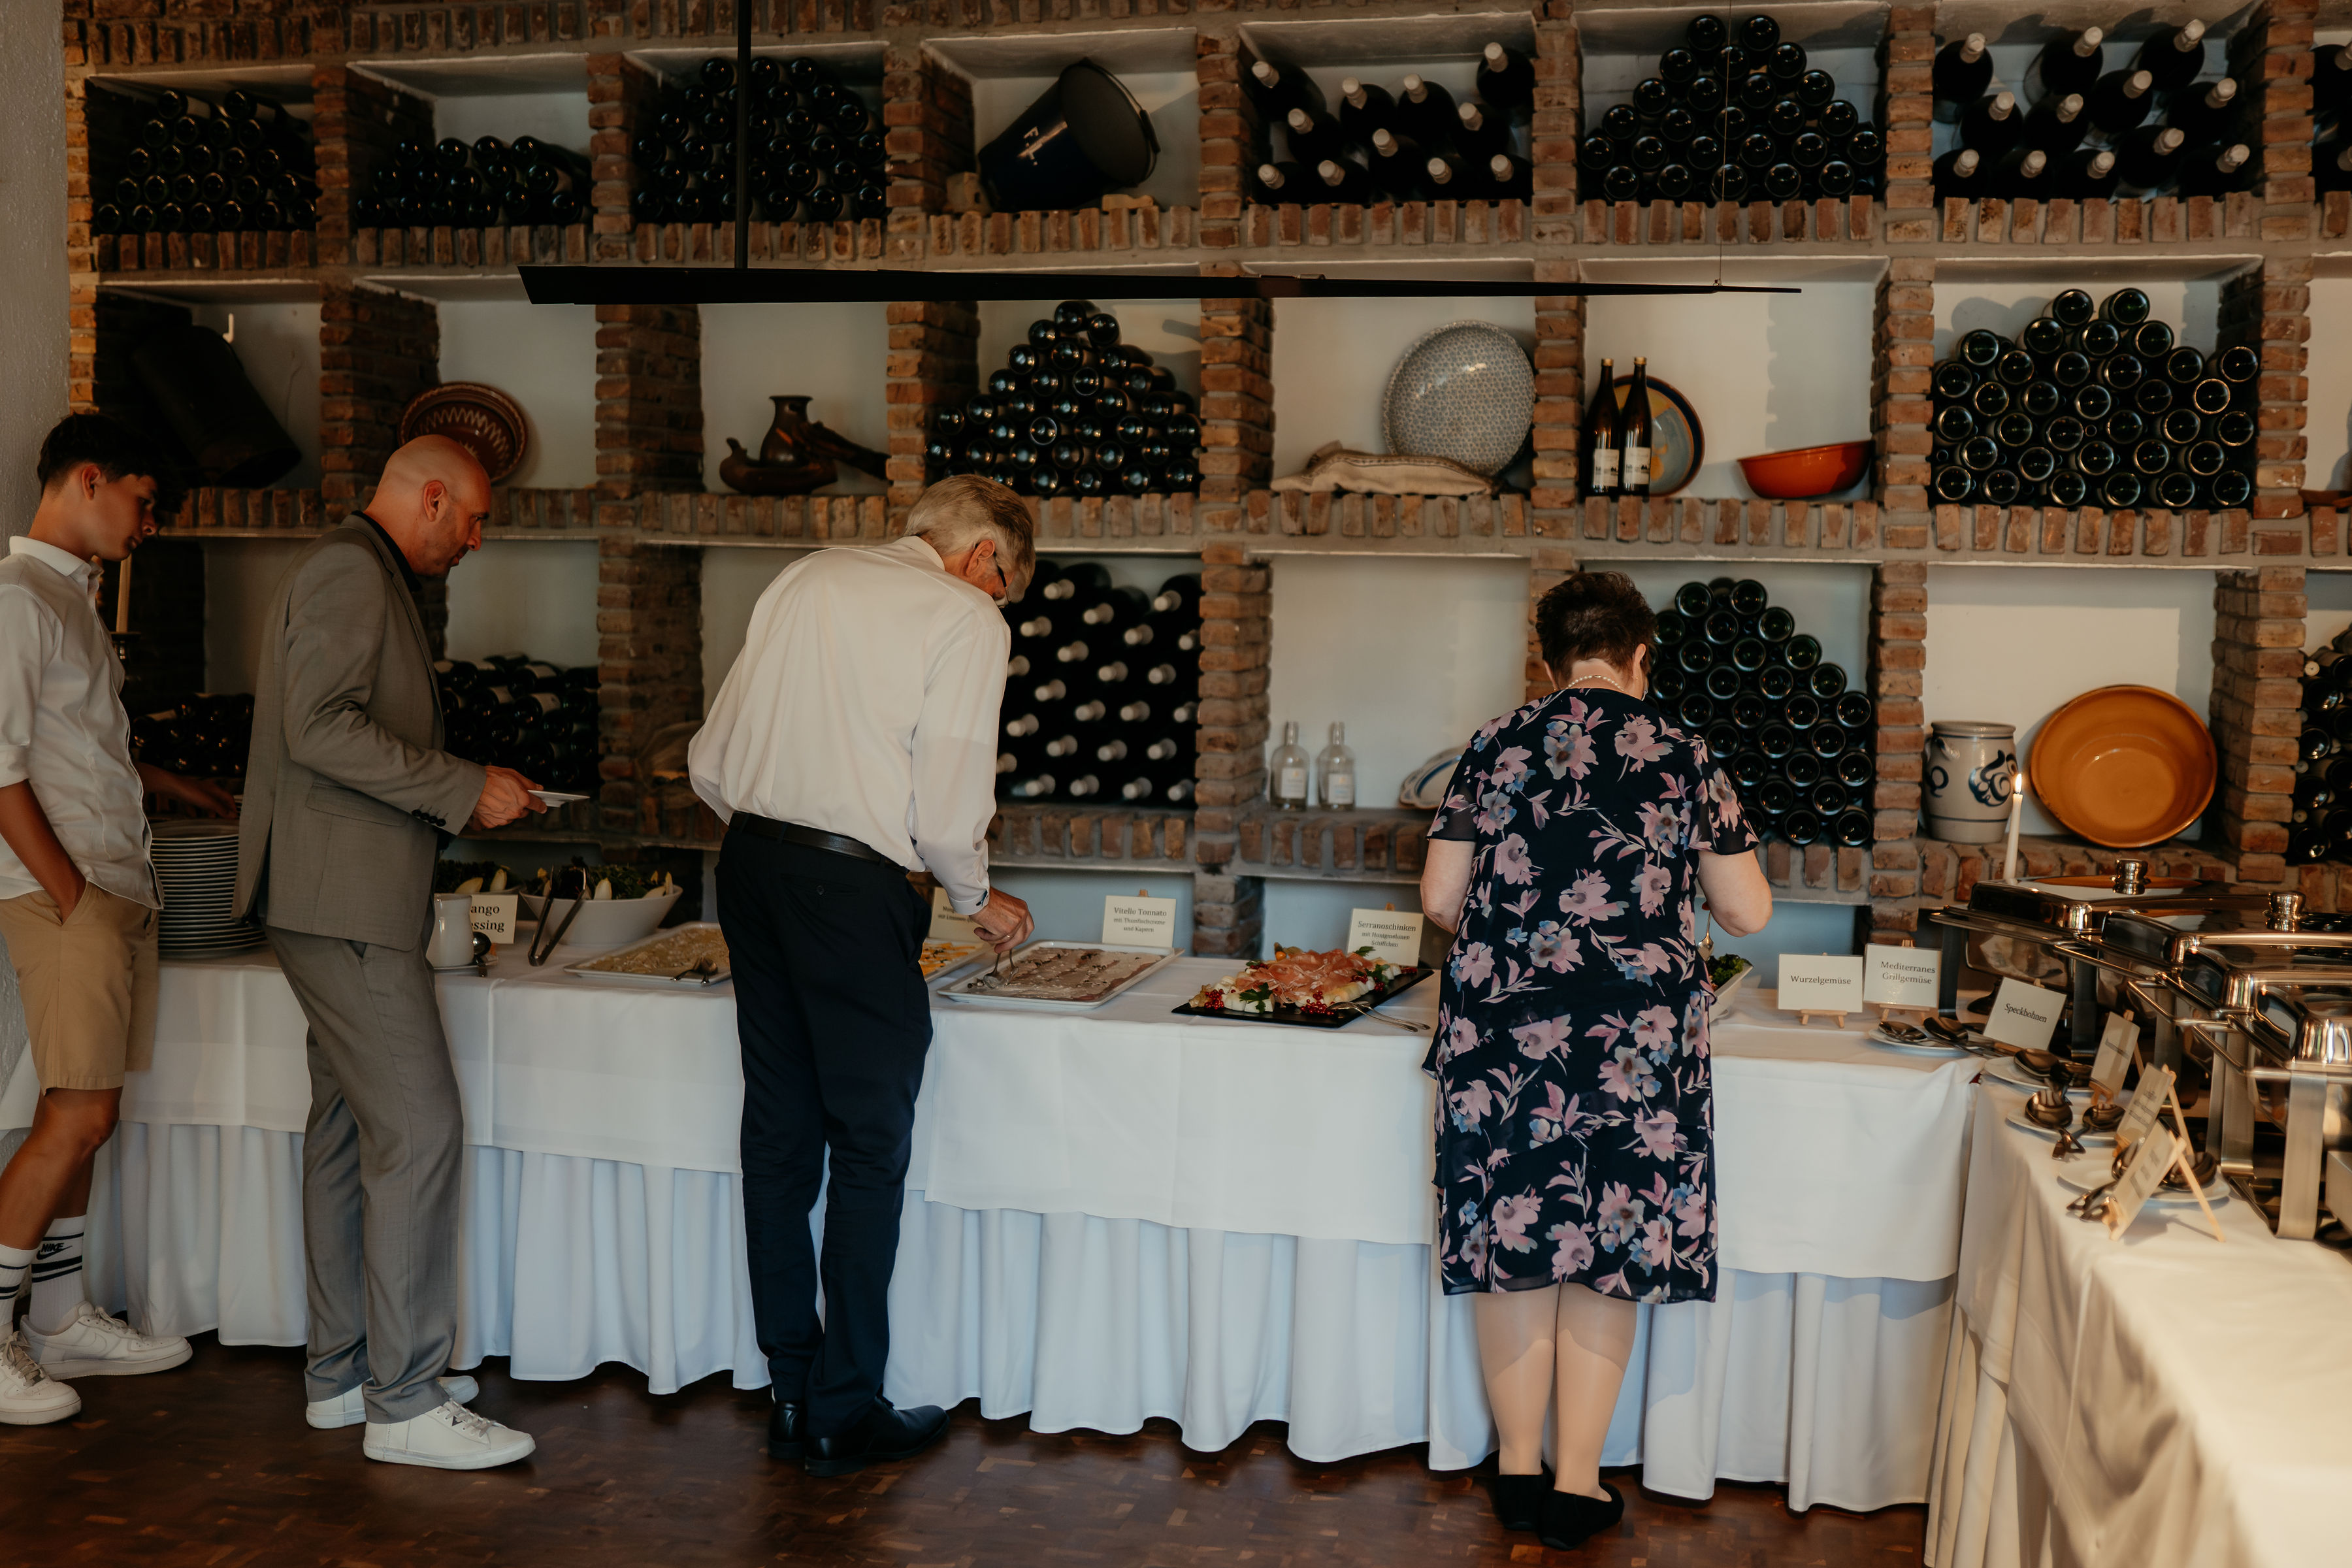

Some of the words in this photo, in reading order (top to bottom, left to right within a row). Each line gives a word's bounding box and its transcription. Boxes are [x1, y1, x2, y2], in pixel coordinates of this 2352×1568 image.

[470, 906, 500, 916] ango
[471, 920, 504, 932] ssing
[1358, 921, 1416, 932] Serranoschinken
[1881, 961, 1936, 973] Mediterranes
[1791, 975, 1852, 985] Wurzelgemüse
[1882, 972, 1932, 985] Grillgemüse
[2004, 1003, 2048, 1023] Speckbohnen
[41, 1243, 64, 1252] NIKE
